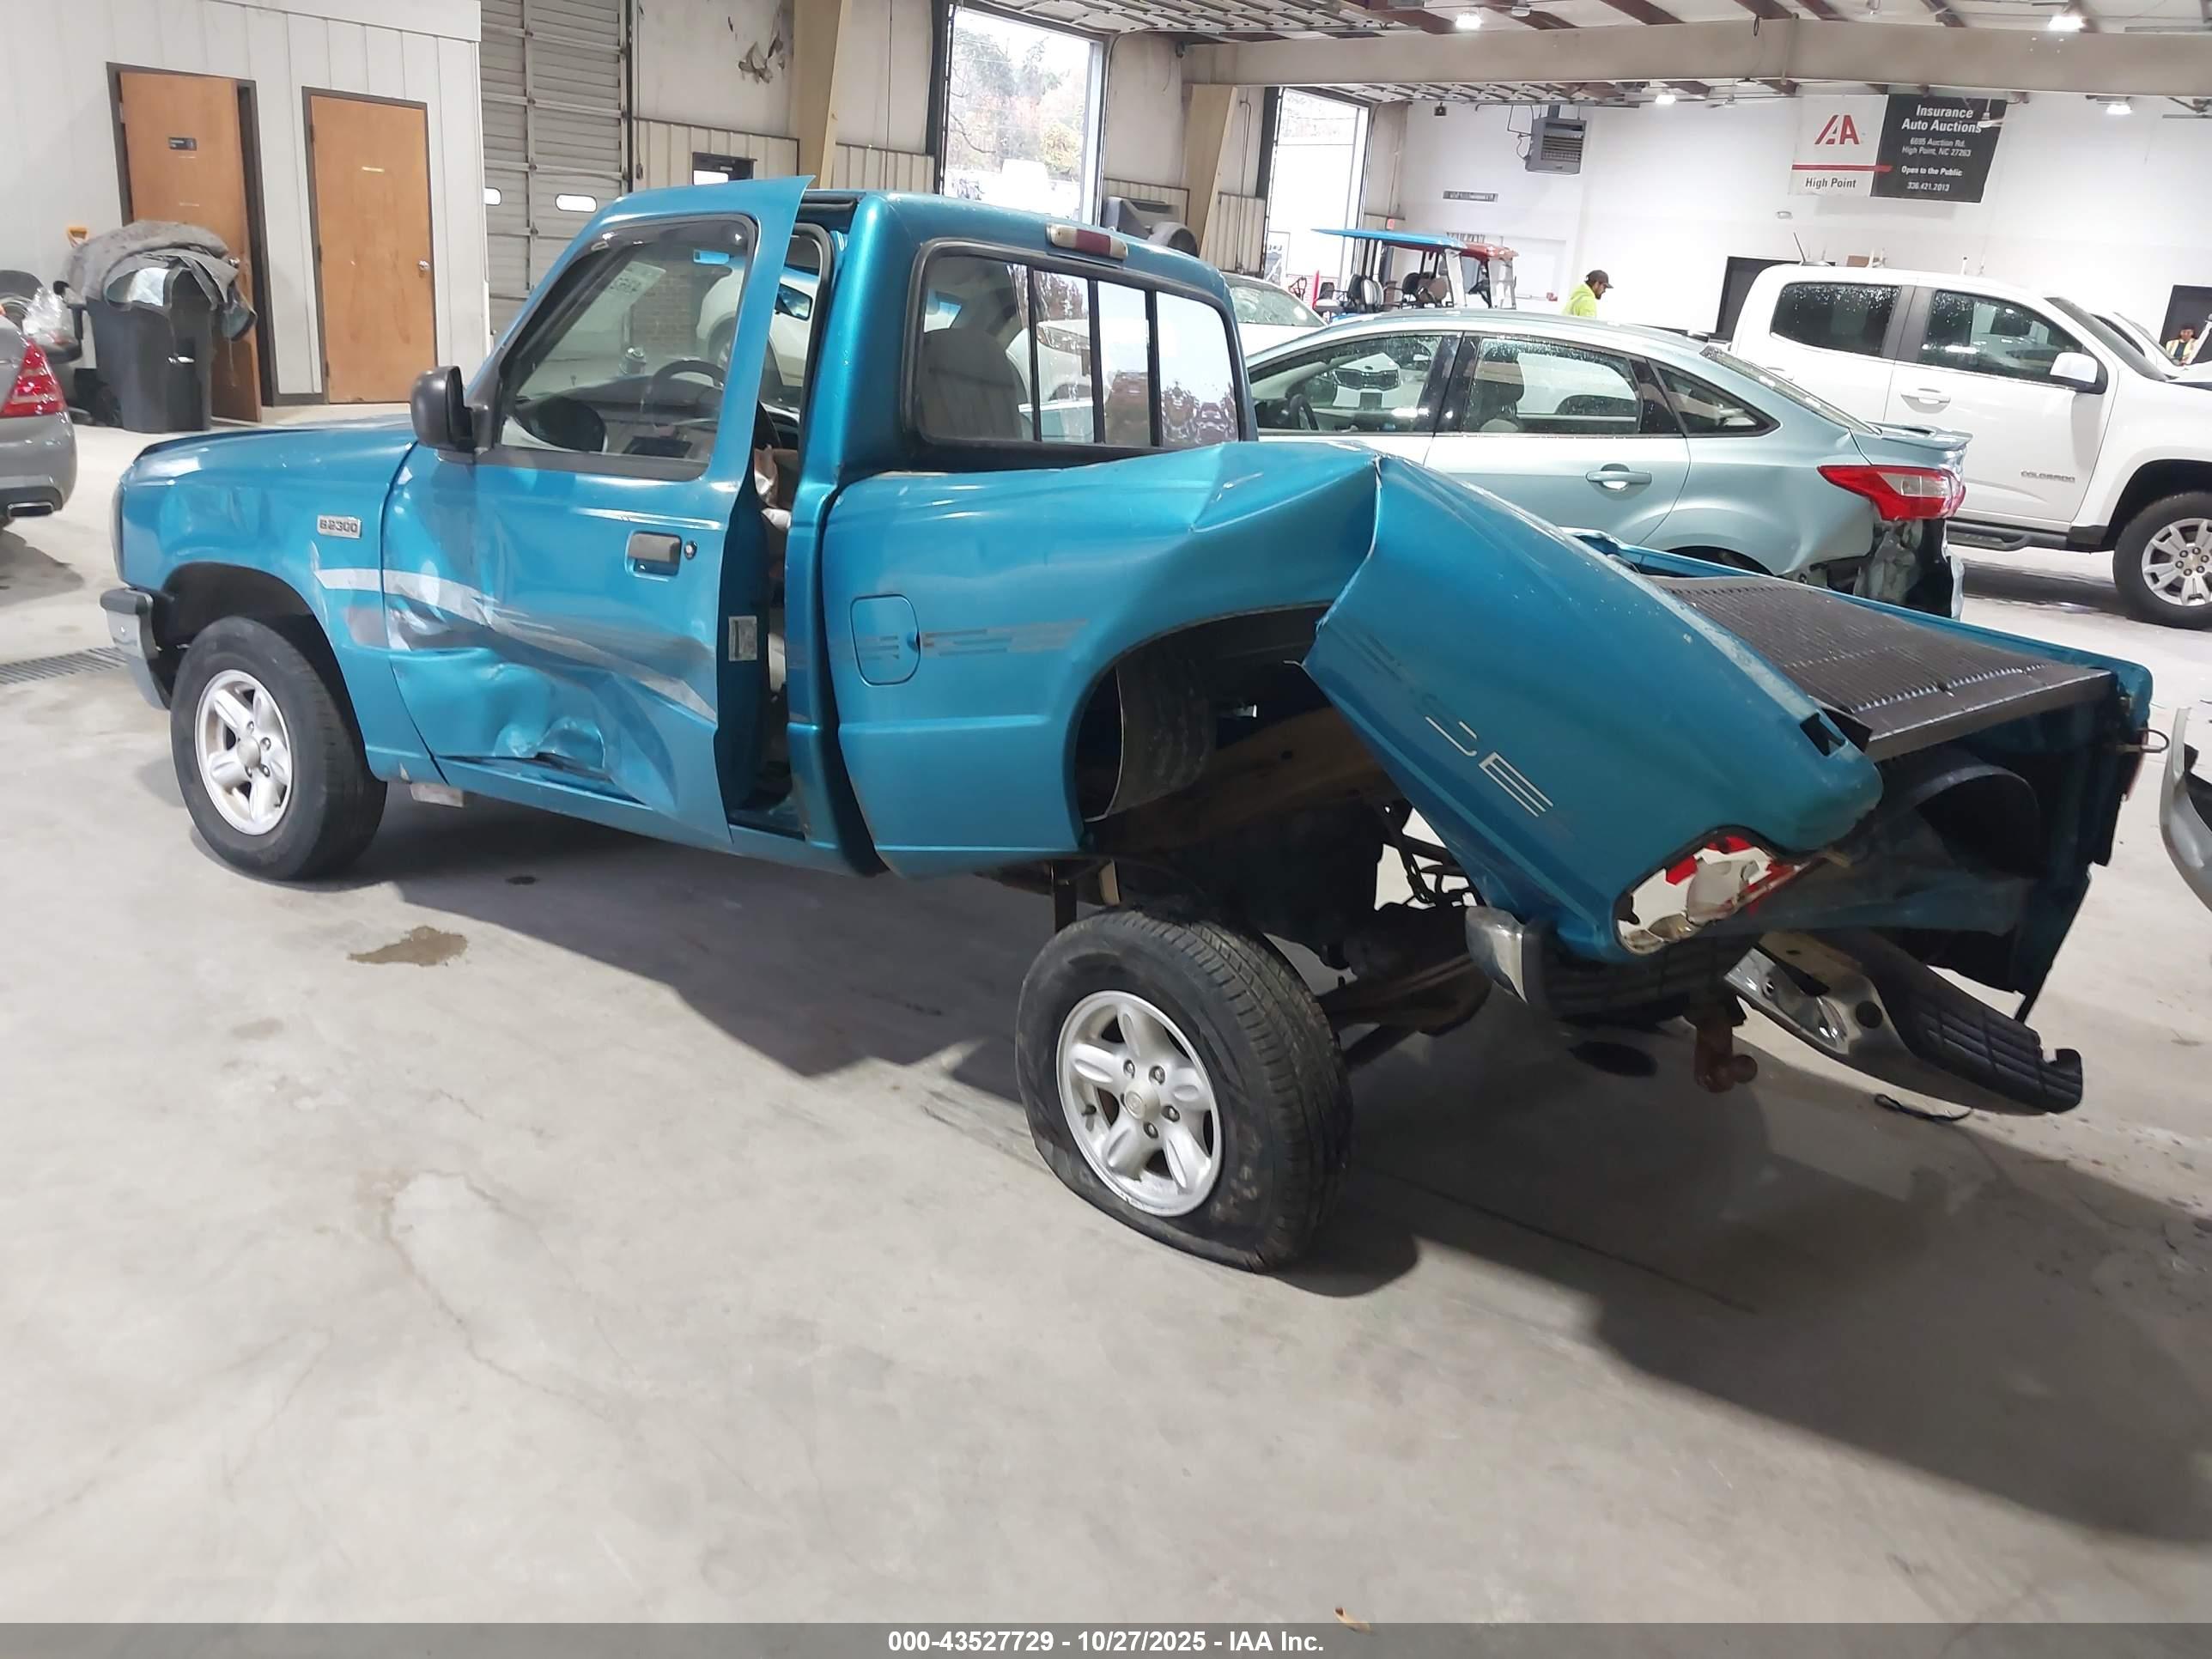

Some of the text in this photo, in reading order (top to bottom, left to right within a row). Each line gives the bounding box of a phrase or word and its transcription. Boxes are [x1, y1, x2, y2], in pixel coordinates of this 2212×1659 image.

[1916, 104, 1973, 118] Insurance
[1901, 118, 1982, 133] Auto Auctions
[1927, 138, 1954, 147] Auction
[1901, 145, 1917, 155] High
[1938, 147, 1951, 155] NC
[1901, 166, 1919, 175] Open
[1940, 167, 1964, 176] Public
[1805, 177, 1856, 190] High Point
